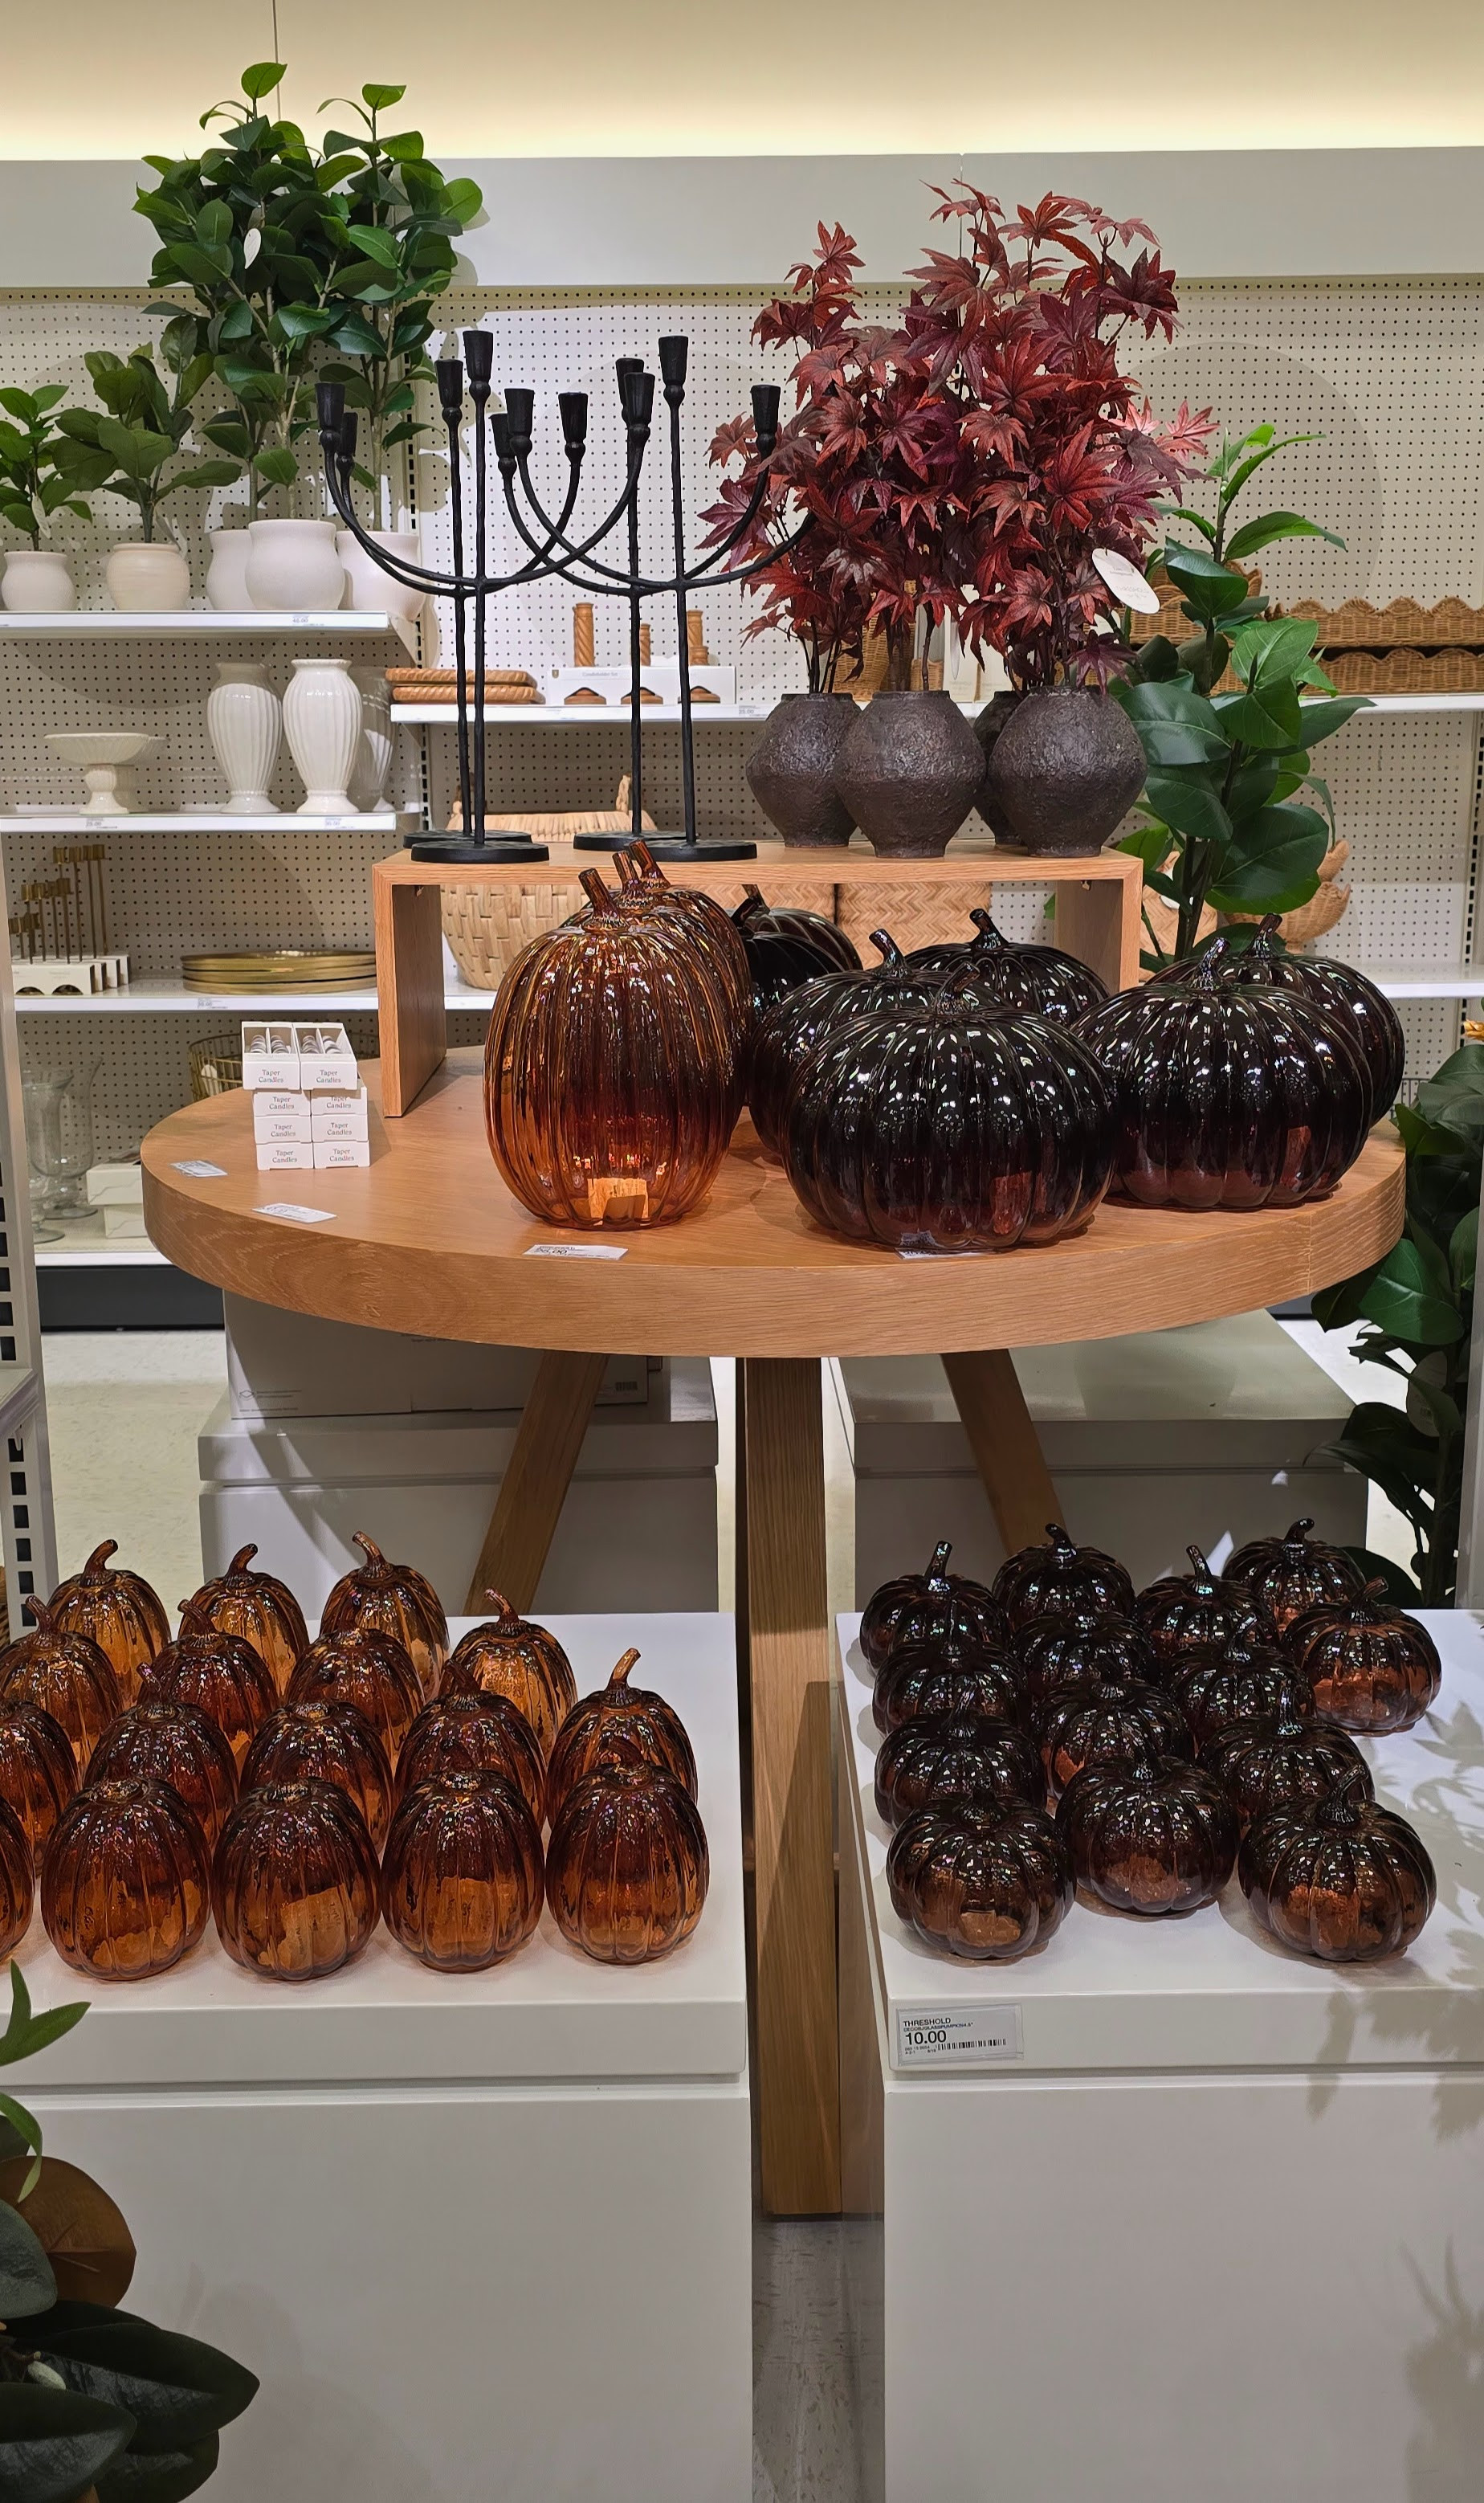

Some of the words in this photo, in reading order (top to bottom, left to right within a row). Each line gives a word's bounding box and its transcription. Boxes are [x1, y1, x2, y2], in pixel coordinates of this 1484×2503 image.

[262, 1069, 280, 1078] Taper
[320, 1069, 338, 1078] Taper
[273, 1096, 292, 1105] Taper
[331, 1122, 349, 1130] Taper
[276, 1149, 294, 1158] Taper
[333, 1148, 351, 1156] Taper
[903, 2018, 951, 2027] THRESHOLD
[905, 2030, 946, 2045] 10.00
